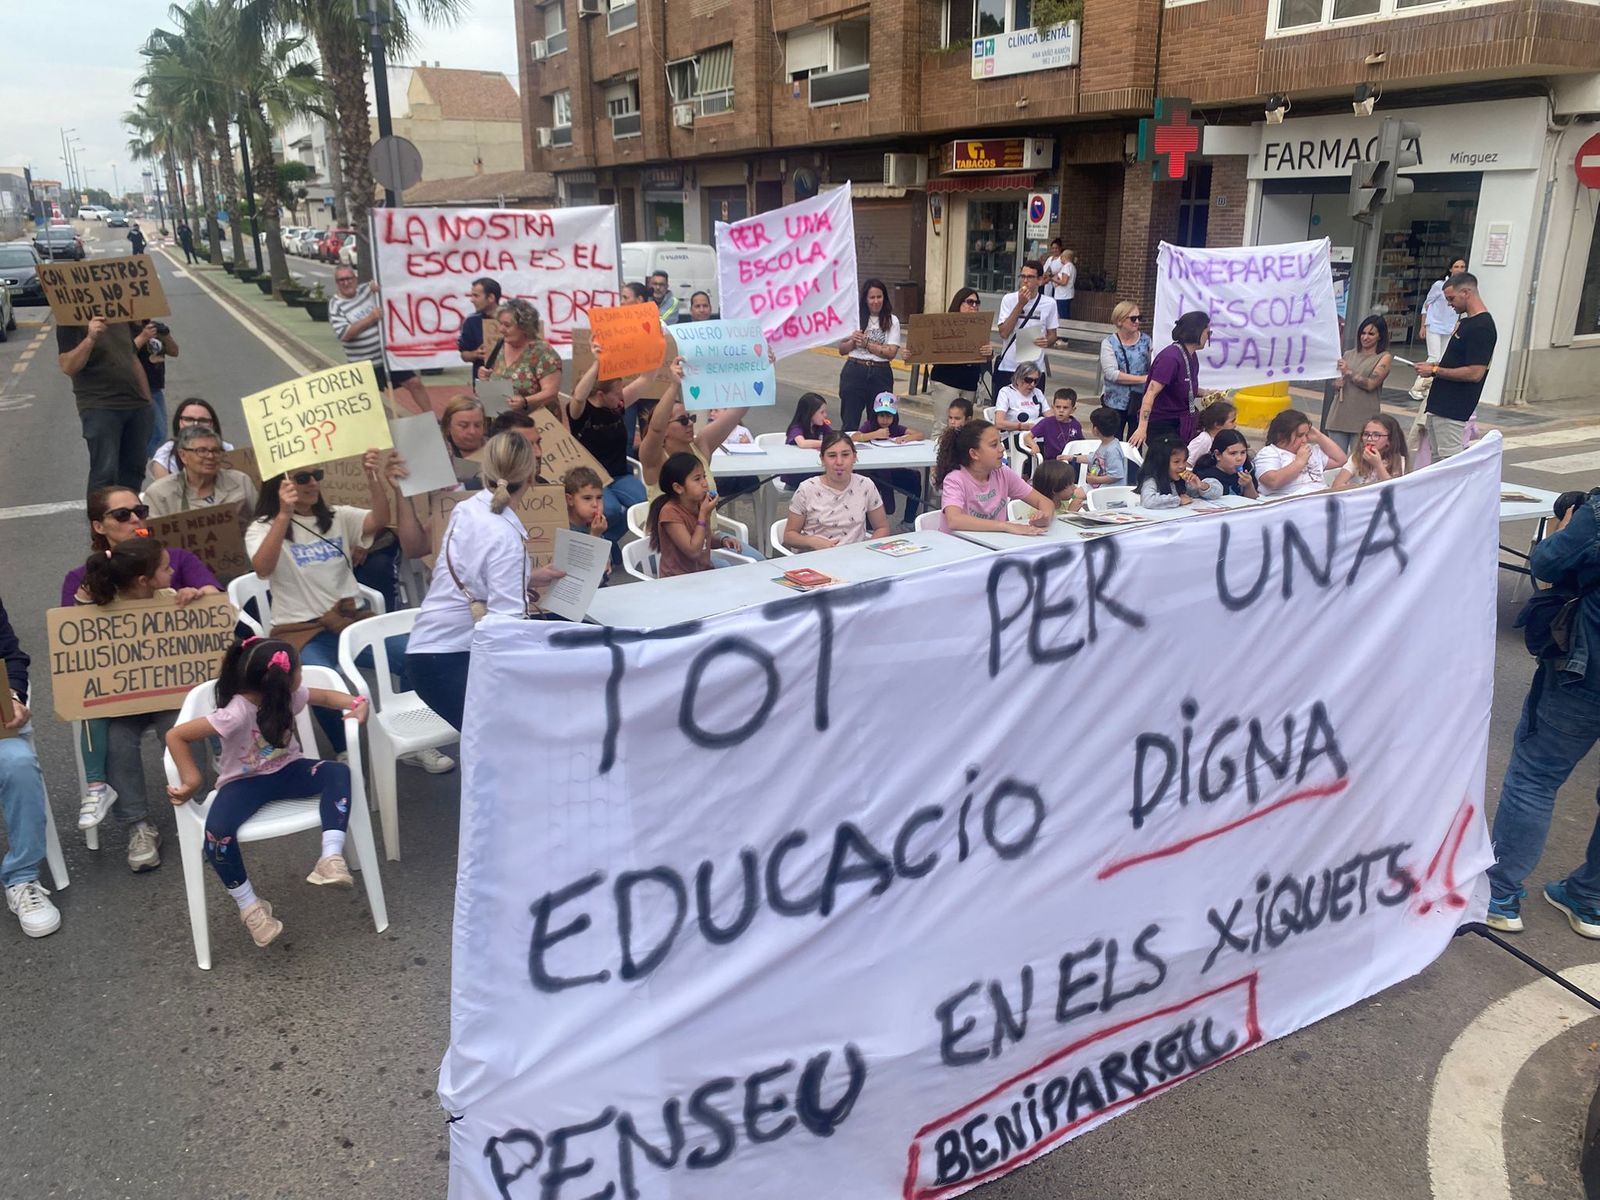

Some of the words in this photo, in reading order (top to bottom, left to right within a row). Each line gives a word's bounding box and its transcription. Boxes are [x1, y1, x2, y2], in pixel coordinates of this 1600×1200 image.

[1008, 33, 1038, 48] CLÍNICA
[1040, 26, 1071, 42] DENTAL
[956, 159, 996, 168] TABACOS
[1264, 135, 1423, 171] FARMACA
[385, 210, 431, 248] LA
[439, 212, 556, 241] NOSTRA
[729, 222, 771, 250] PER
[784, 210, 832, 239] UNA
[70, 260, 148, 283] NUESTROS
[406, 249, 518, 278] ESCOLA
[529, 248, 566, 271] ES
[572, 244, 614, 271] EL
[738, 242, 826, 284] ESCOLA
[101, 283, 123, 301] NO
[129, 280, 150, 297] SE
[73, 299, 133, 321] JUEGA!
[676, 326, 722, 340] QUIERO
[726, 325, 761, 338] VOLVER
[695, 345, 703, 357] A
[708, 345, 718, 356] MI
[723, 344, 747, 356] COLE
[1206, 336, 1307, 377] JA!!!
[706, 361, 767, 374] BENIPARRELL
[260, 396, 272, 419] I
[306, 367, 364, 398] FOREN
[264, 417, 293, 441] ELS
[296, 392, 372, 427] VOSTRES
[161, 521, 180, 535] DE
[187, 510, 233, 529] MENOS
[205, 530, 218, 543] A
[59, 614, 137, 645] OBRES
[158, 631, 234, 657] RENOVADES
[548, 579, 892, 774] TOT
[986, 534, 1146, 677] PER
[1216, 486, 1408, 611] UNA
[84, 676, 109, 699] AL
[113, 659, 217, 694] SETEMBRE
[484, 1043, 866, 1200] PENSEU
[936, 964, 1033, 1066] EN
[1056, 924, 1167, 1023] ELS
